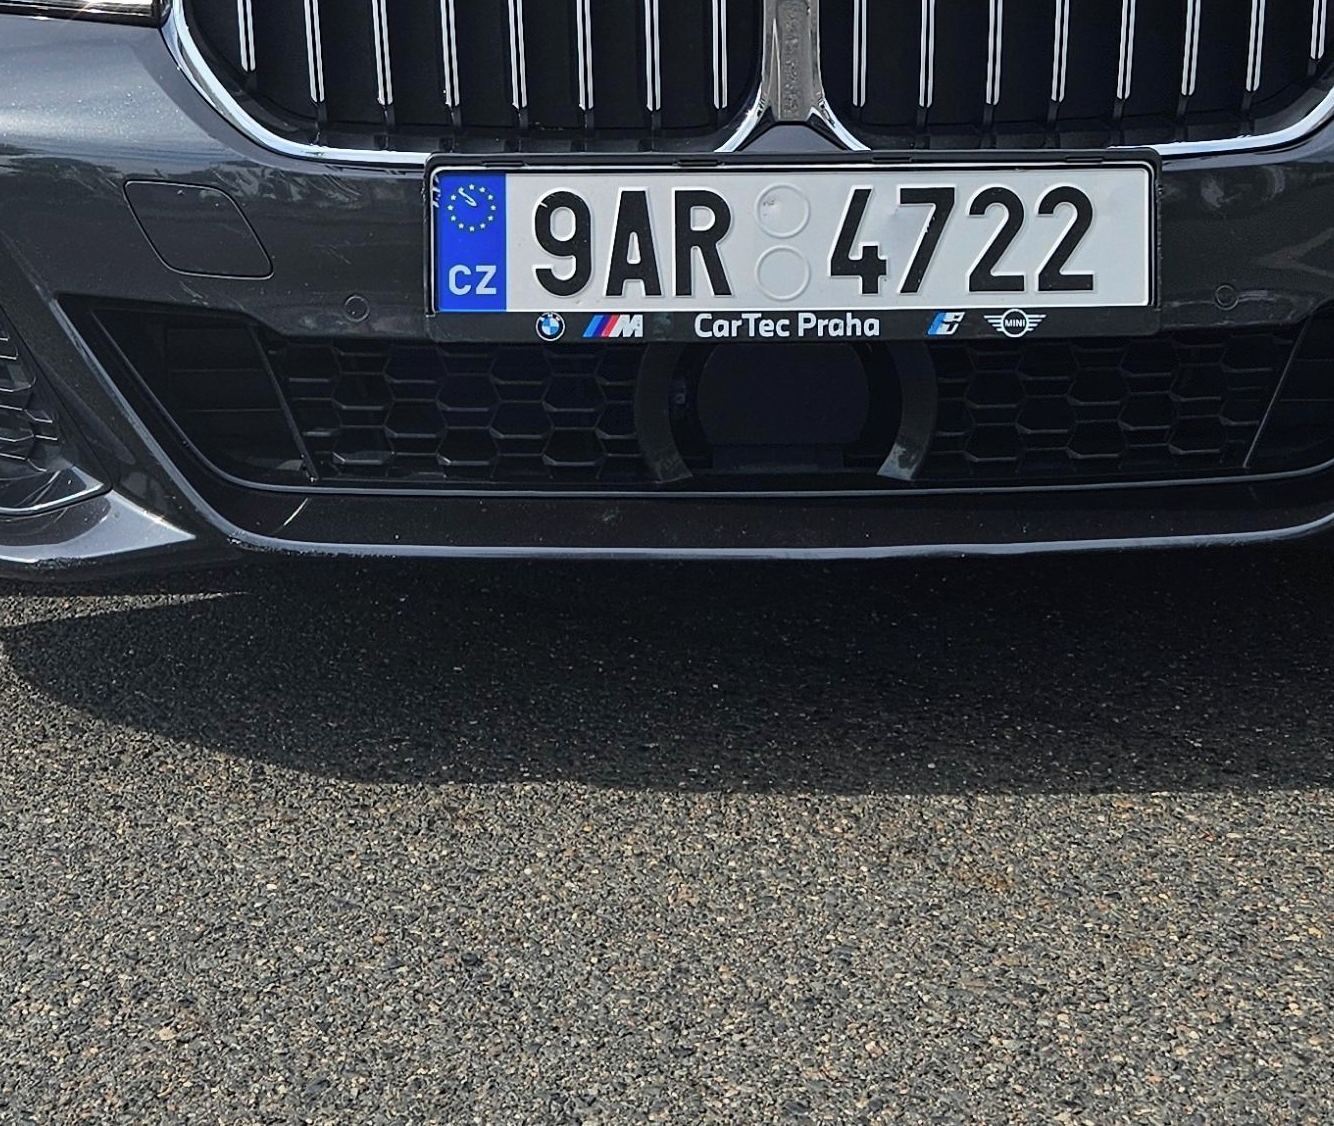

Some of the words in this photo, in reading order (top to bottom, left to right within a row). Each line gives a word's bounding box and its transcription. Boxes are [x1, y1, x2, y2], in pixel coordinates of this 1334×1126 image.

[534, 189, 732, 297] 9AR
[830, 185, 1094, 294] 4722
[448, 265, 497, 295] CZ
[694, 313, 790, 337] CarTec
[797, 312, 880, 337] Praha
[1005, 319, 1026, 327] MINI
